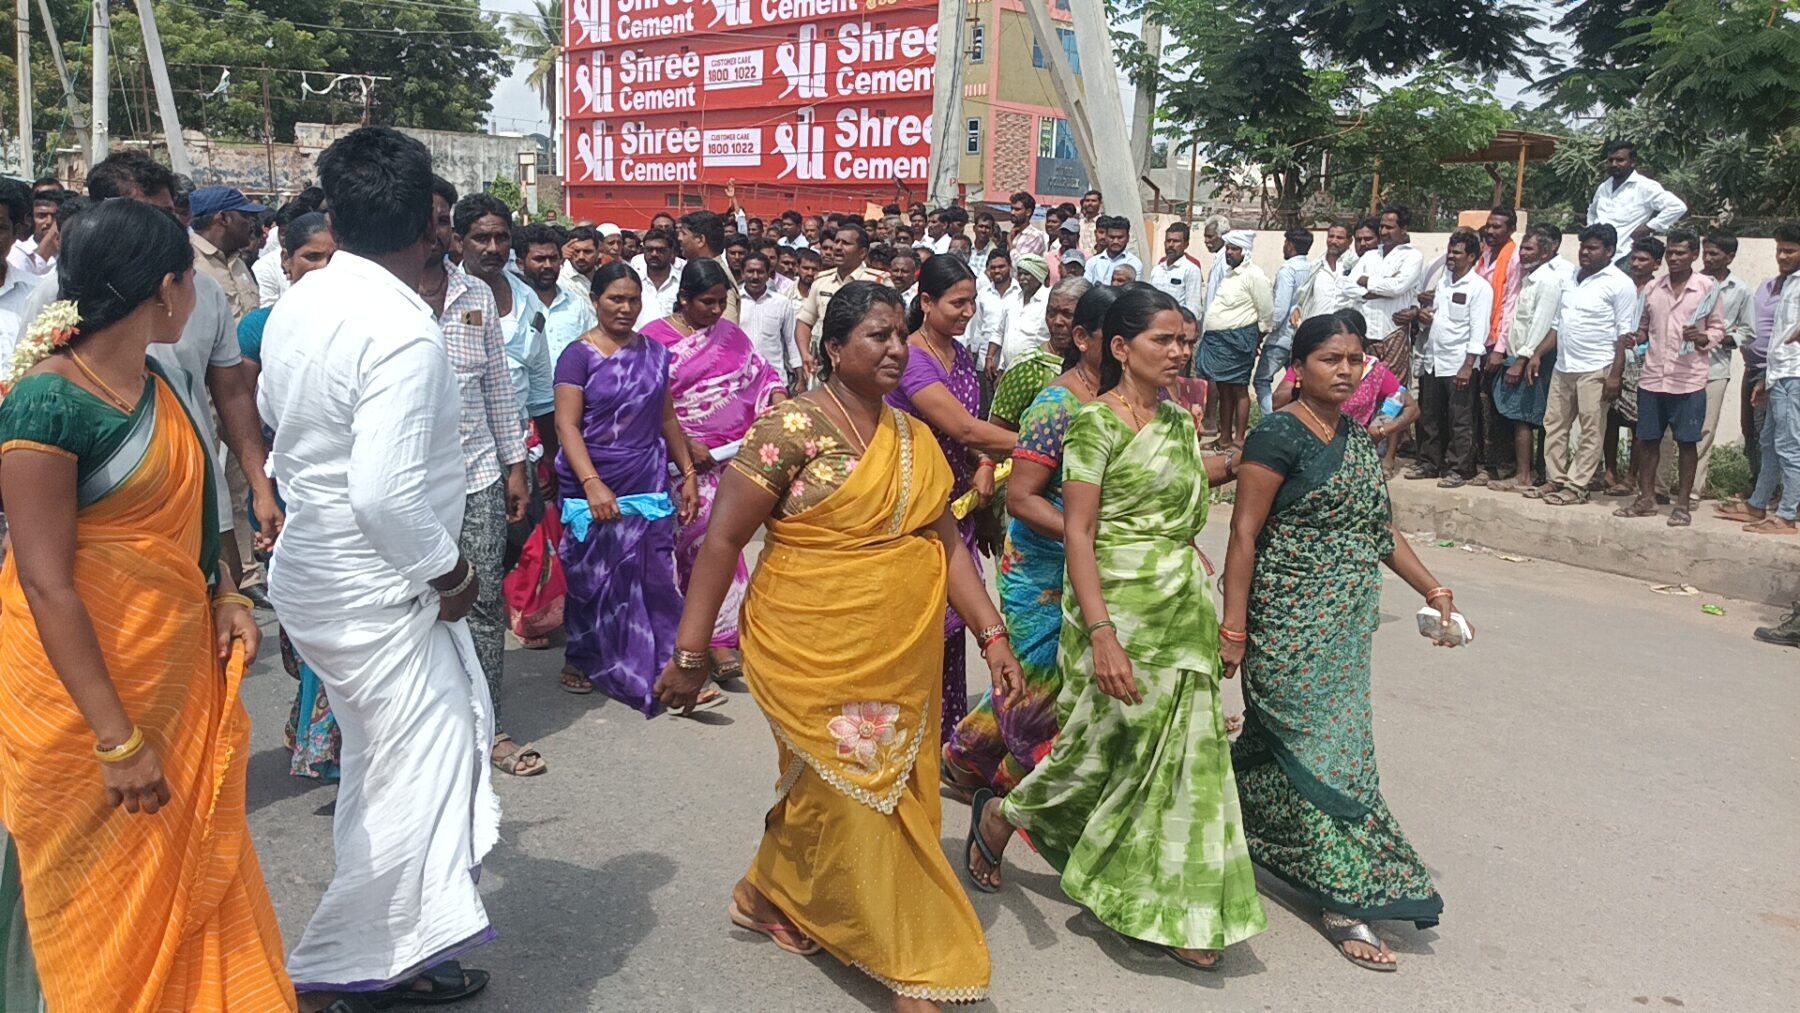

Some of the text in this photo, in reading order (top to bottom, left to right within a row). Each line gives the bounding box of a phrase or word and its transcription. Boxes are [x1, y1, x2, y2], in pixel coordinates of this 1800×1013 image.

[617, 6, 694, 40] Cement
[620, 50, 700, 84] Shree
[708, 65, 757, 82] 1800 1022
[711, 55, 751, 67] CUSTOMER CARE
[620, 82, 696, 111] Cement
[620, 121, 701, 155] Shree
[708, 142, 754, 155] 1800 1022
[620, 157, 697, 182] Cement
[833, 151, 931, 180] Cemen
